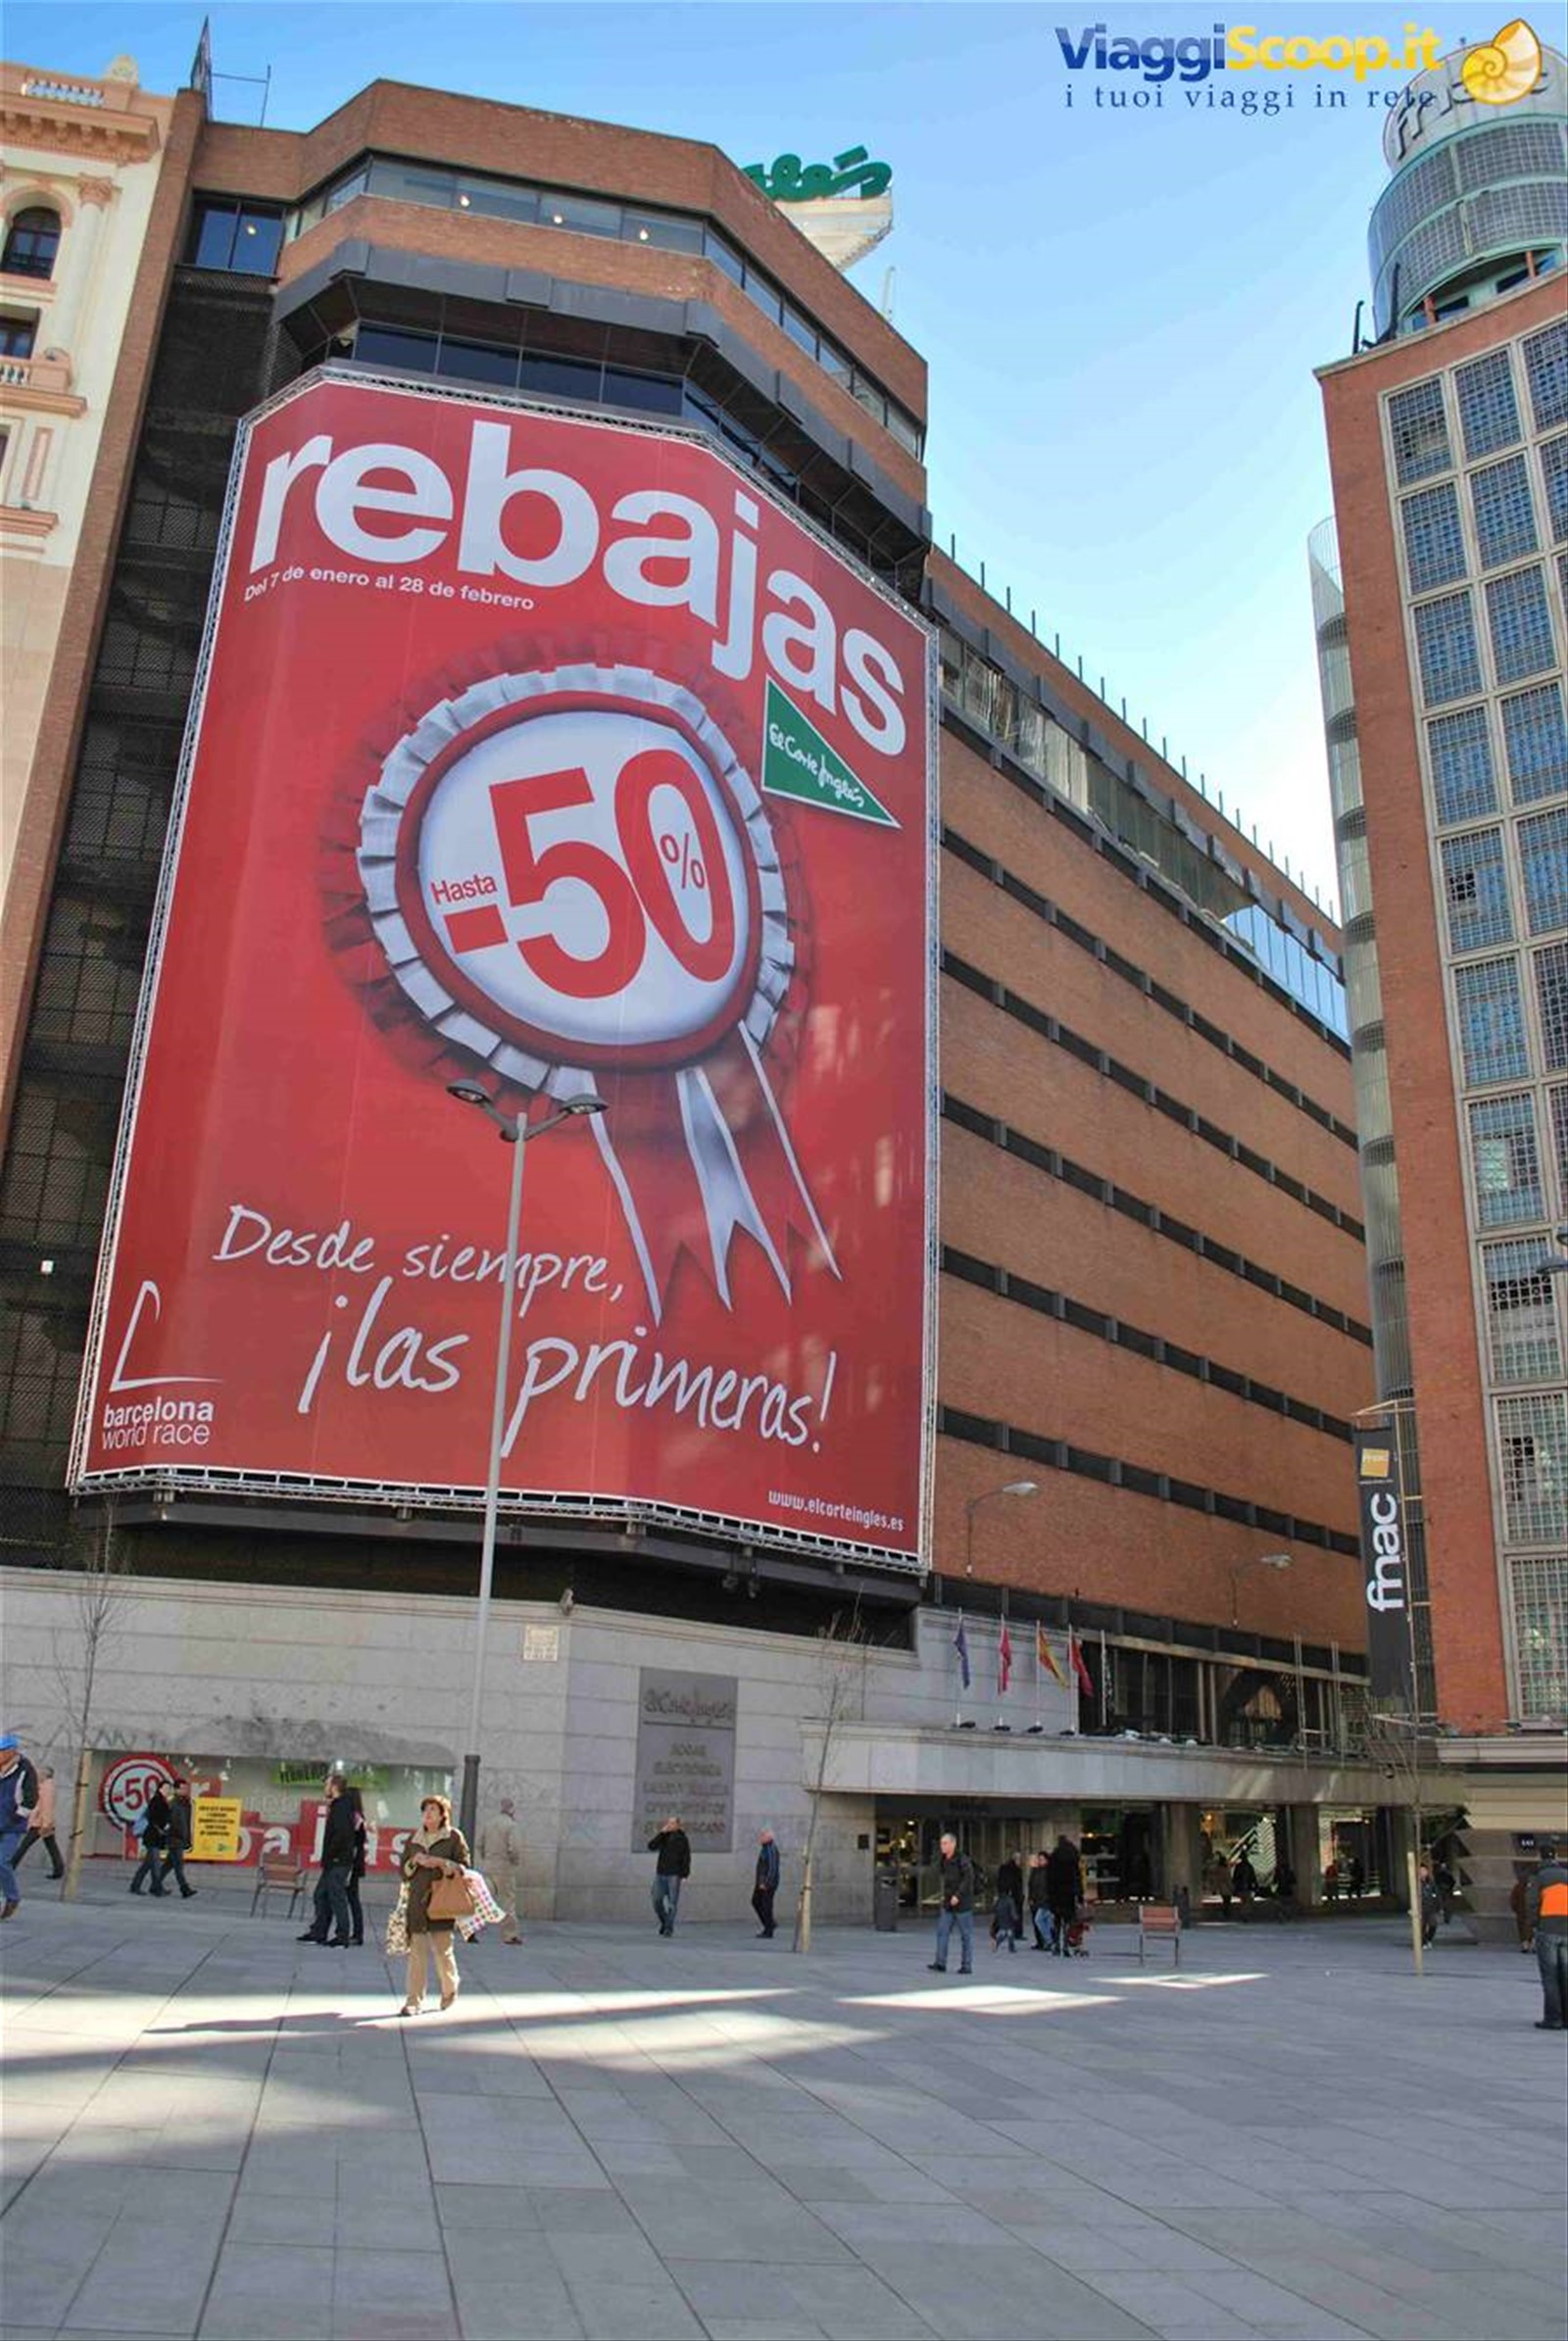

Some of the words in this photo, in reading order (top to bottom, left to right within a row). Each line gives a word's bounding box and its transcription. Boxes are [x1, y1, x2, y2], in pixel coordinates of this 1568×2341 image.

[244, 580, 269, 602] Del
[270, 572, 280, 588] 7
[282, 565, 304, 582] de
[310, 566, 369, 586] enero
[375, 574, 394, 589] al
[400, 576, 423, 594] 28
[429, 581, 455, 598] de
[461, 585, 535, 610] febrero
[250, 419, 906, 756] rebajas
[430, 873, 498, 904] Hasta
[213, 1204, 374, 1273] Desde
[403, 1235, 624, 1319] siempre,
[103, 1396, 214, 1428] barcelona
[500, 1326, 836, 1458] primeras!
[102, 1424, 147, 1450] world
[152, 1423, 211, 1445] race
[768, 1489, 905, 1532] www.elcorteingles.es
[1366, 1492, 1404, 1612] fnac
